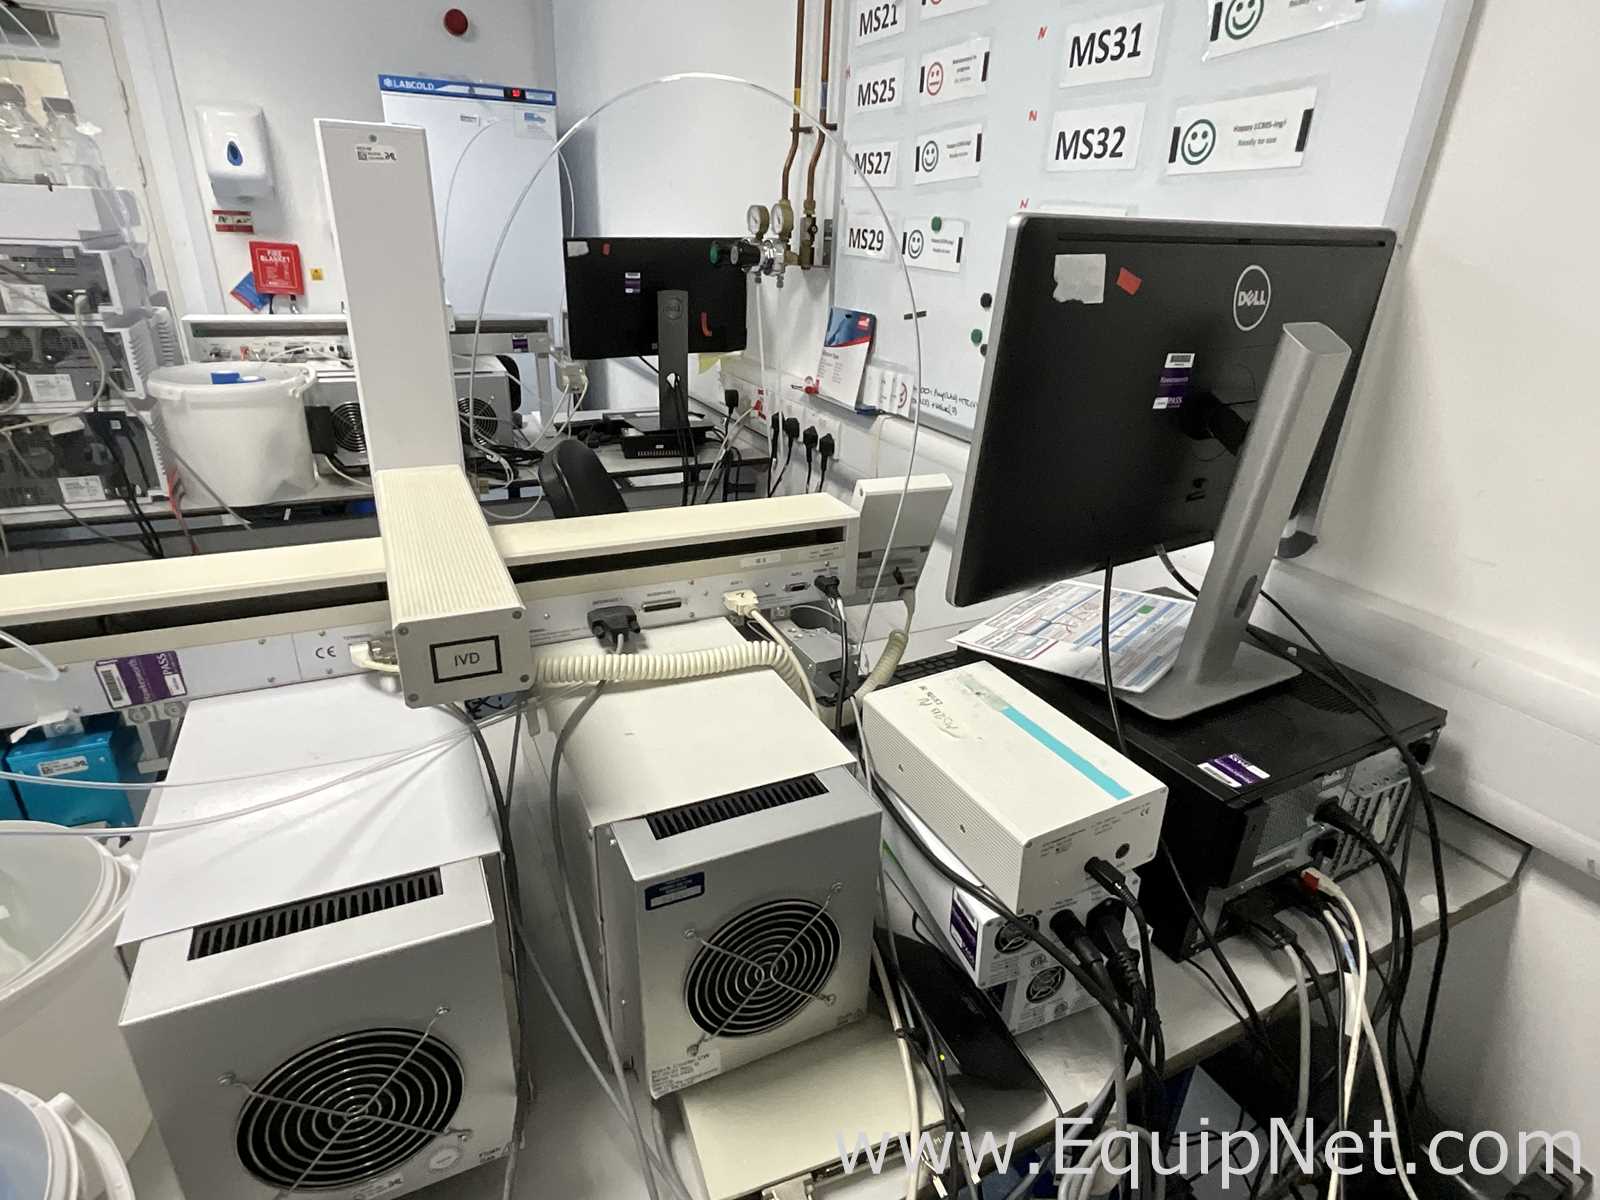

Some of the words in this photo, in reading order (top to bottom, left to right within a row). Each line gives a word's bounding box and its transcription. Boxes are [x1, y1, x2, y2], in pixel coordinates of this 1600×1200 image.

[859, 3, 898, 37] MS21
[1038, 26, 1048, 40] N
[1069, 22, 1143, 69] MS31
[392, 78, 434, 91] LABCOLD
[857, 77, 896, 107] MS25
[1028, 110, 1037, 121] N
[1055, 126, 1126, 161] MS32
[854, 151, 891, 176] MS27
[848, 227, 884, 252] MS29
[1237, 289, 1266, 307] DELL
[156, 652, 174, 676] PASS
[454, 652, 481, 667] IVD
